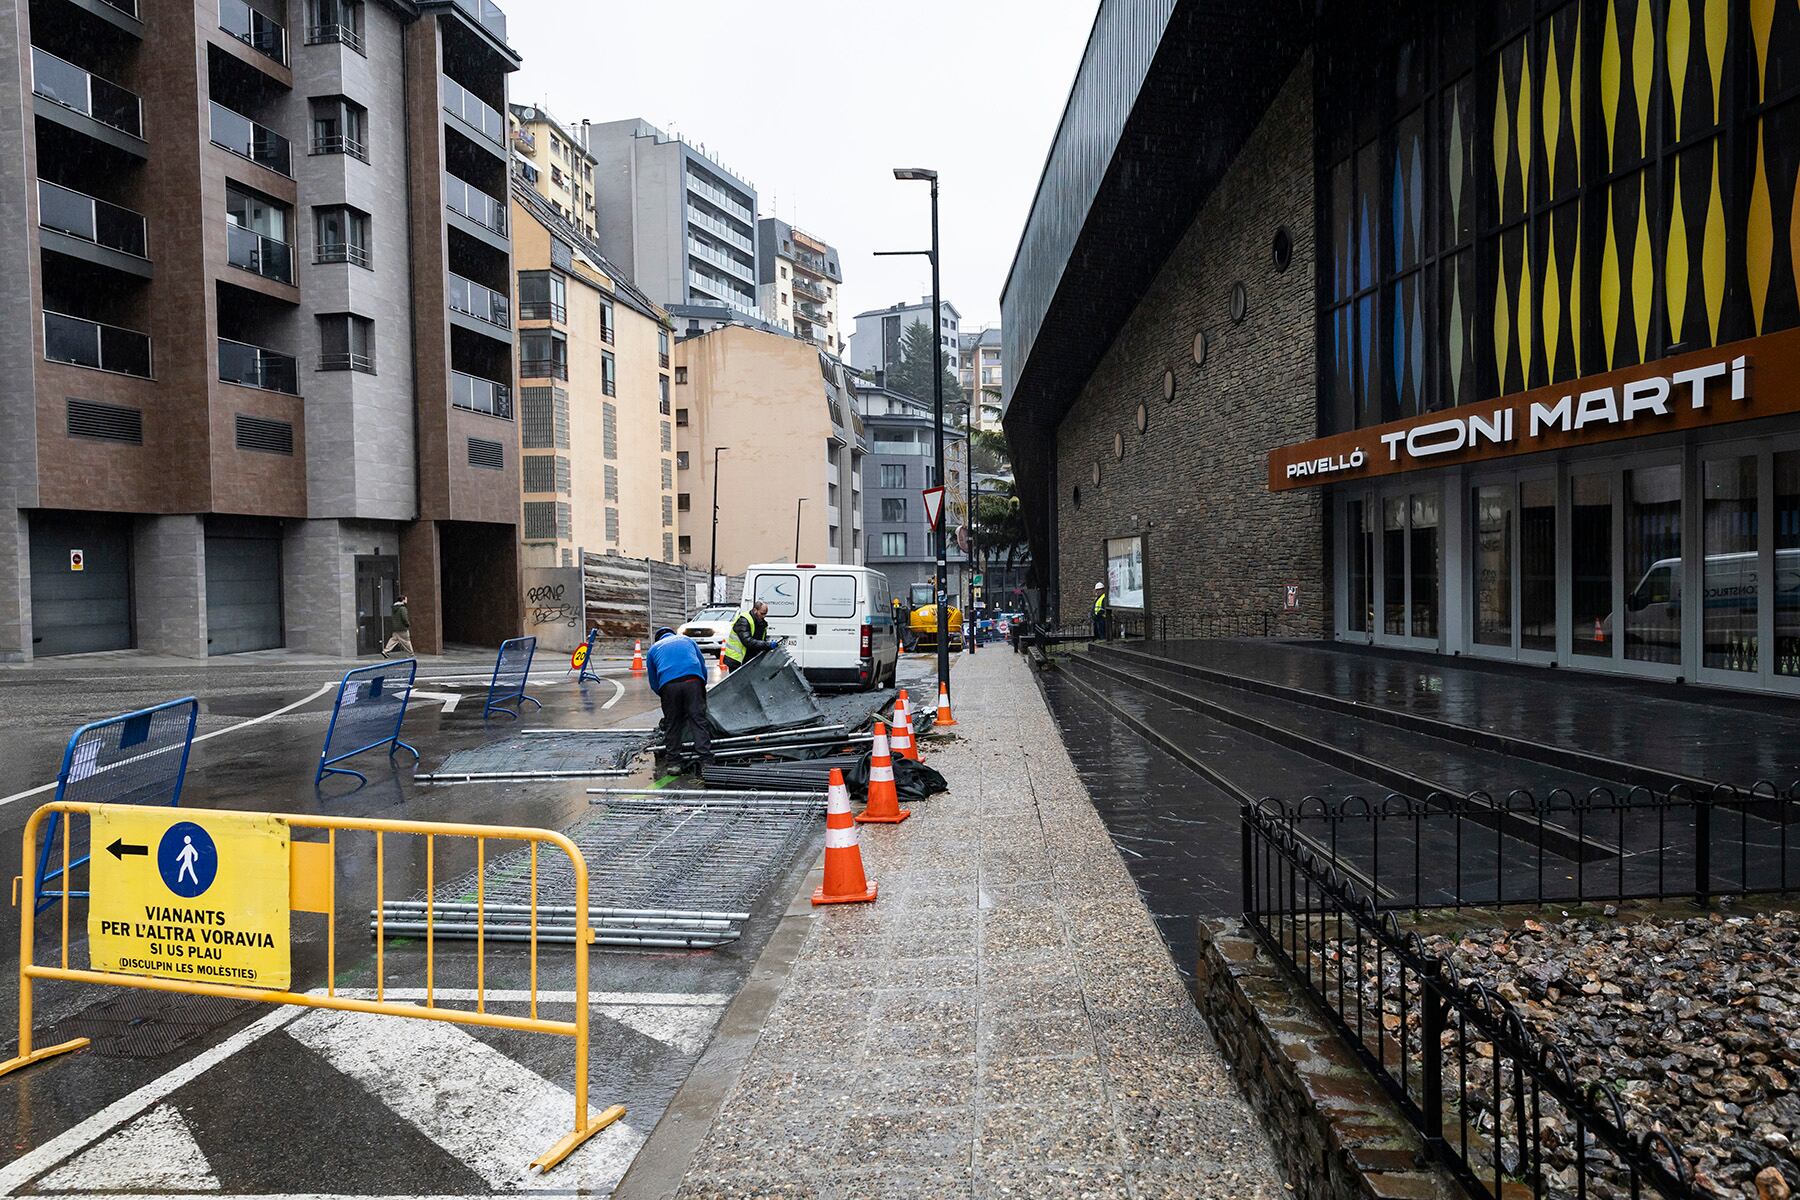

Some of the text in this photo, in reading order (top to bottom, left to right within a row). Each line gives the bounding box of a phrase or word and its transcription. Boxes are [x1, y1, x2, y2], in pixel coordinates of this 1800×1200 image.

[1286, 354, 1747, 479] PAVELLÓ TONI MARTÍ
[575, 651, 586, 661] 20
[145, 905, 226, 926] VIANANTS
[101, 920, 275, 949] PER L'ALTRA VORAVIA
[150, 942, 223, 960] SI US PLAU
[119, 957, 173, 972] (DISCULPIN
[175, 962, 194, 974] LES
